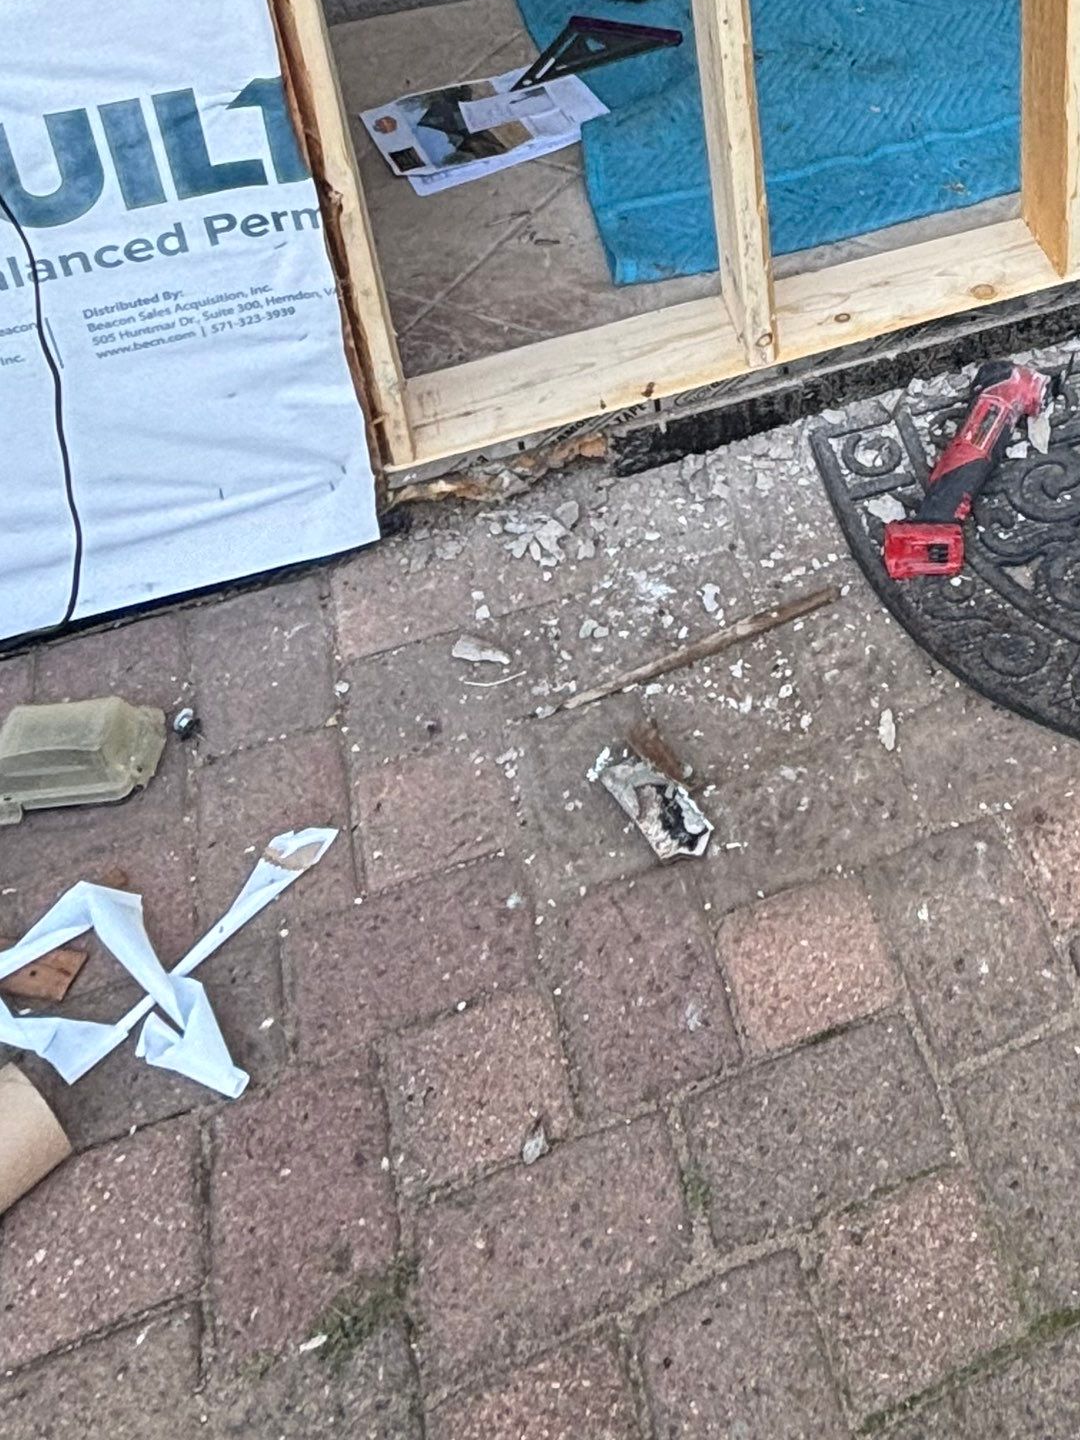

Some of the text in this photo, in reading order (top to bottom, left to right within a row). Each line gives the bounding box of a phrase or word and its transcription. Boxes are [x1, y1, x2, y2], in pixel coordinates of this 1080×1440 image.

[82, 293, 160, 320] Distributed
[201, 307, 235, 321] Suite
[86, 316, 136, 333] Beacon
[138, 307, 172, 321] Sales
